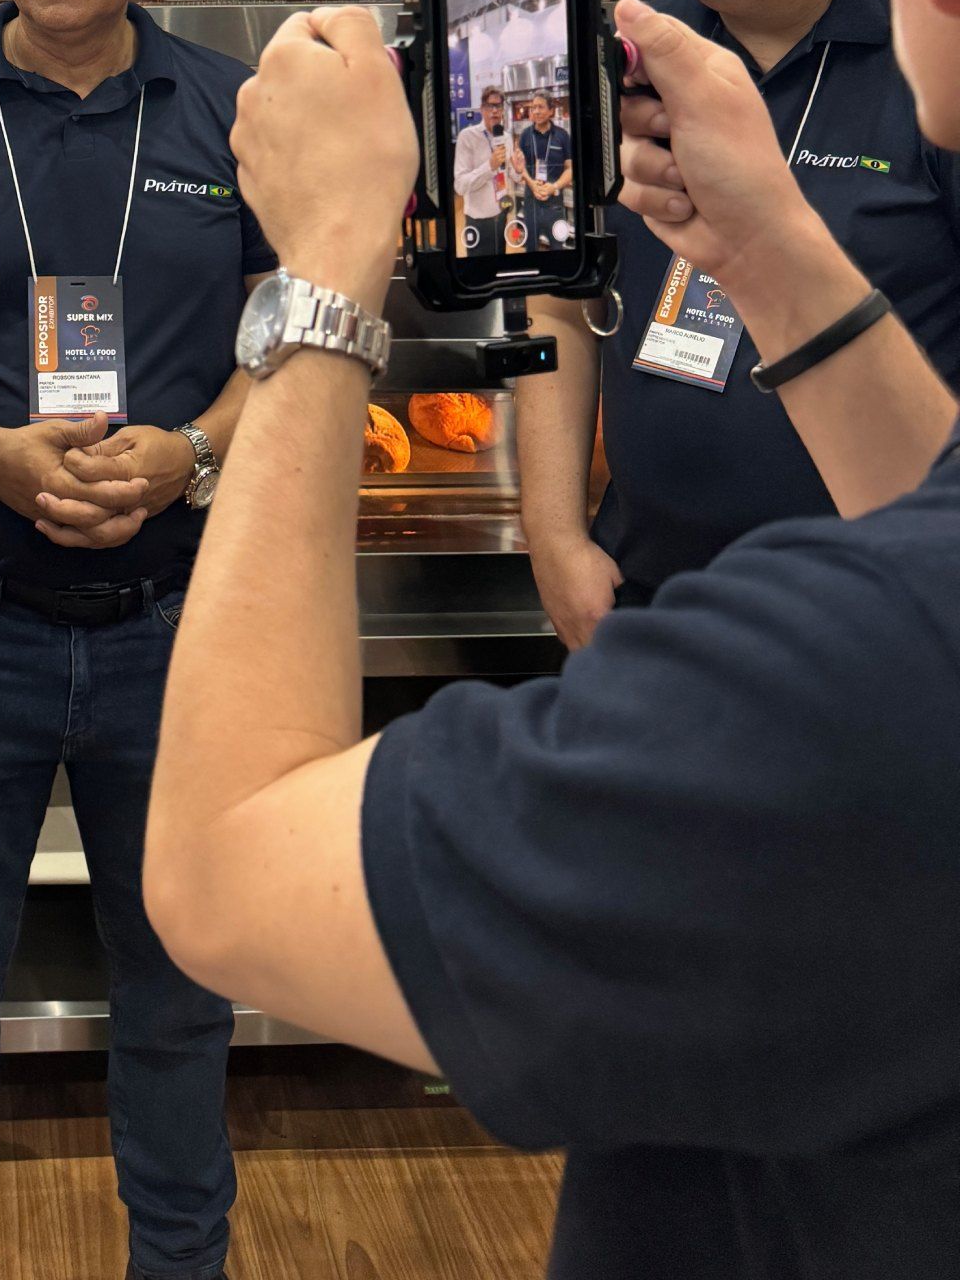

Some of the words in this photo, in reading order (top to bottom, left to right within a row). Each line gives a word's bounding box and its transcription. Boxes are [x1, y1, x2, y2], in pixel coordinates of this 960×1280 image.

[66, 313, 94, 322] SUPER
[96, 313, 114, 322] MIX
[686, 307, 707, 318] HOTEL
[715, 313, 735, 324] FOOD
[38, 295, 49, 365] EXPOSITOR
